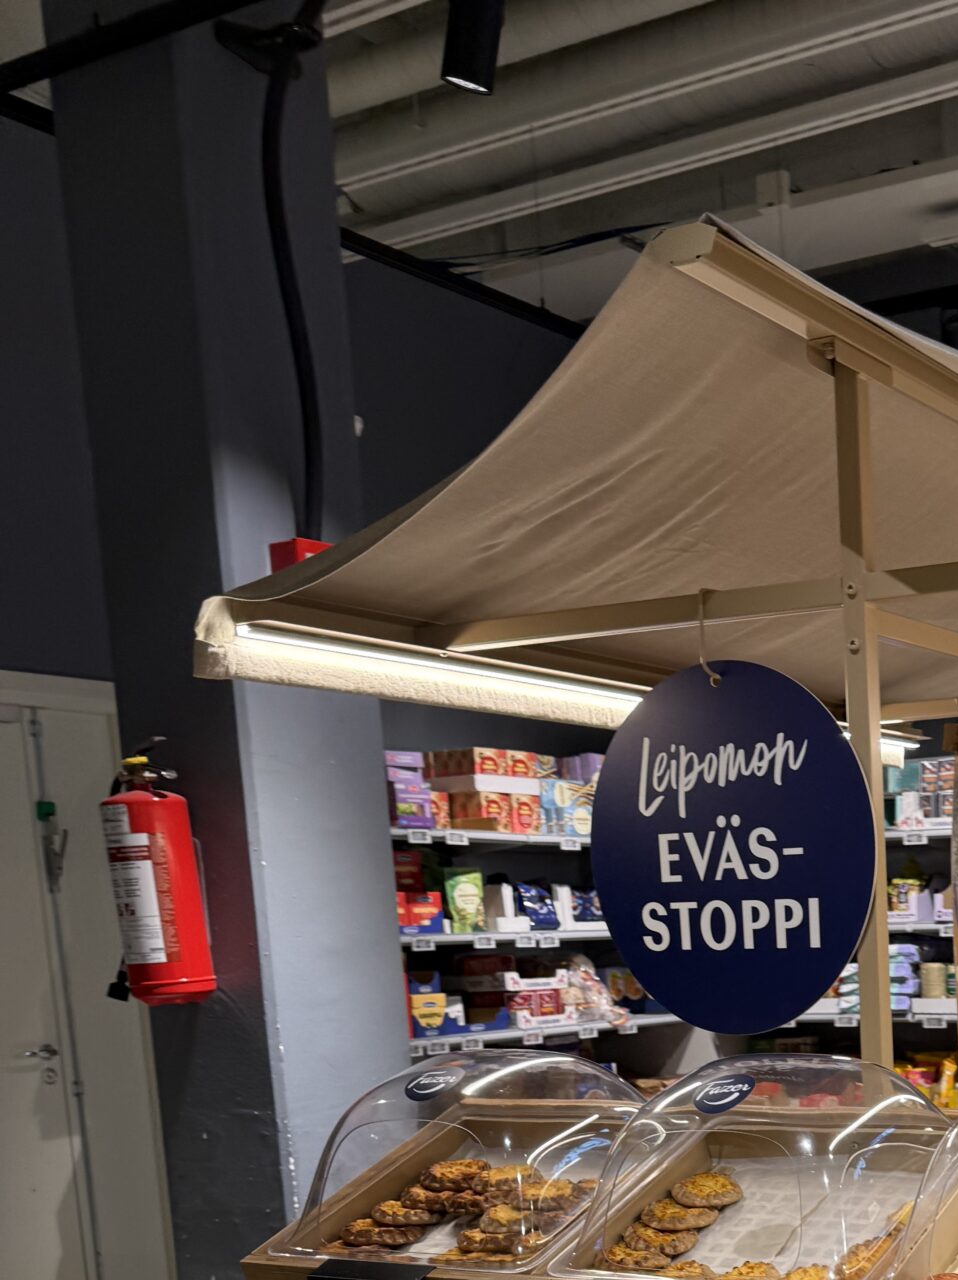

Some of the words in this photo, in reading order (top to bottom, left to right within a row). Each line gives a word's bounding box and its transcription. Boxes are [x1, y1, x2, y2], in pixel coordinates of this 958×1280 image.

[638, 732, 809, 819] Leipomon
[657, 814, 804, 883] EVÄS-
[641, 897, 821, 952] STOPPI
[407, 1071, 457, 1089] Fazer
[696, 1079, 751, 1101] Fazer
